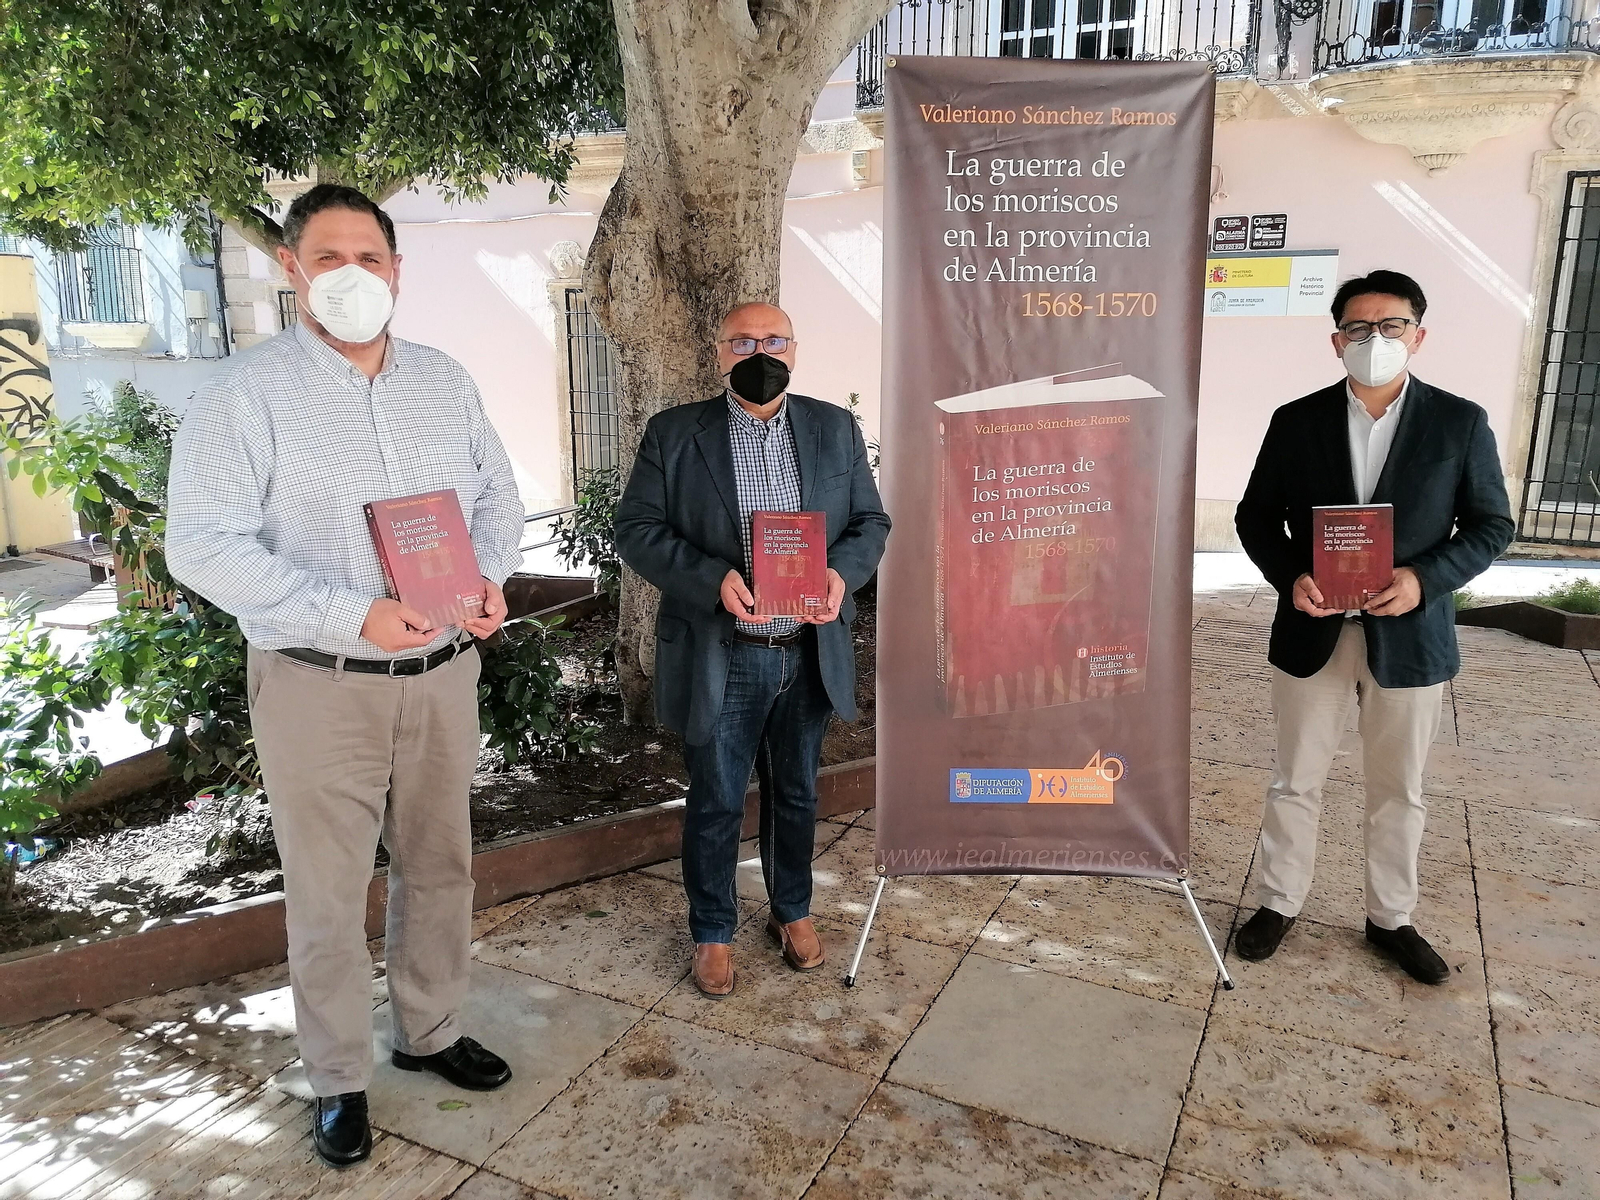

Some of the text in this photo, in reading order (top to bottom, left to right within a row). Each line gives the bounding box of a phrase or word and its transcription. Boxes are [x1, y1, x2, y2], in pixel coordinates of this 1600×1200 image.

[920, 104, 1176, 126] Valeriano Sánchez Ramos
[946, 150, 1126, 186] La guerra de
[944, 186, 1118, 213] los moriscos
[944, 222, 1151, 256] en la provincia
[944, 258, 1098, 282] de Almería
[1022, 292, 1157, 317] 1568-1570
[975, 414, 1130, 435] Valeriano Sánchez Ramos
[973, 456, 1096, 484] La guerra de
[972, 479, 1090, 503] los moriscos
[972, 498, 1112, 523] en la provincia
[391, 521, 402, 529] La
[403, 517, 426, 528] guerra
[394, 524, 438, 537] los moriscos
[972, 520, 1076, 544] de Almería
[415, 530, 449, 544] provincia
[1025, 536, 1116, 559] 1568-1570
[400, 542, 439, 555] de Almería
[1090, 643, 1128, 654] historia
[1090, 652, 1136, 662] Instituto de
[1089, 667, 1138, 678] Almerienses
[1090, 660, 1123, 670] Estudios
[1083, 749, 1124, 782] 40
[973, 778, 1023, 787] DIPUTACIÓN
[986, 786, 1023, 795] ALMERÍA
[880, 842, 1188, 875] www.iealmerienses.es
